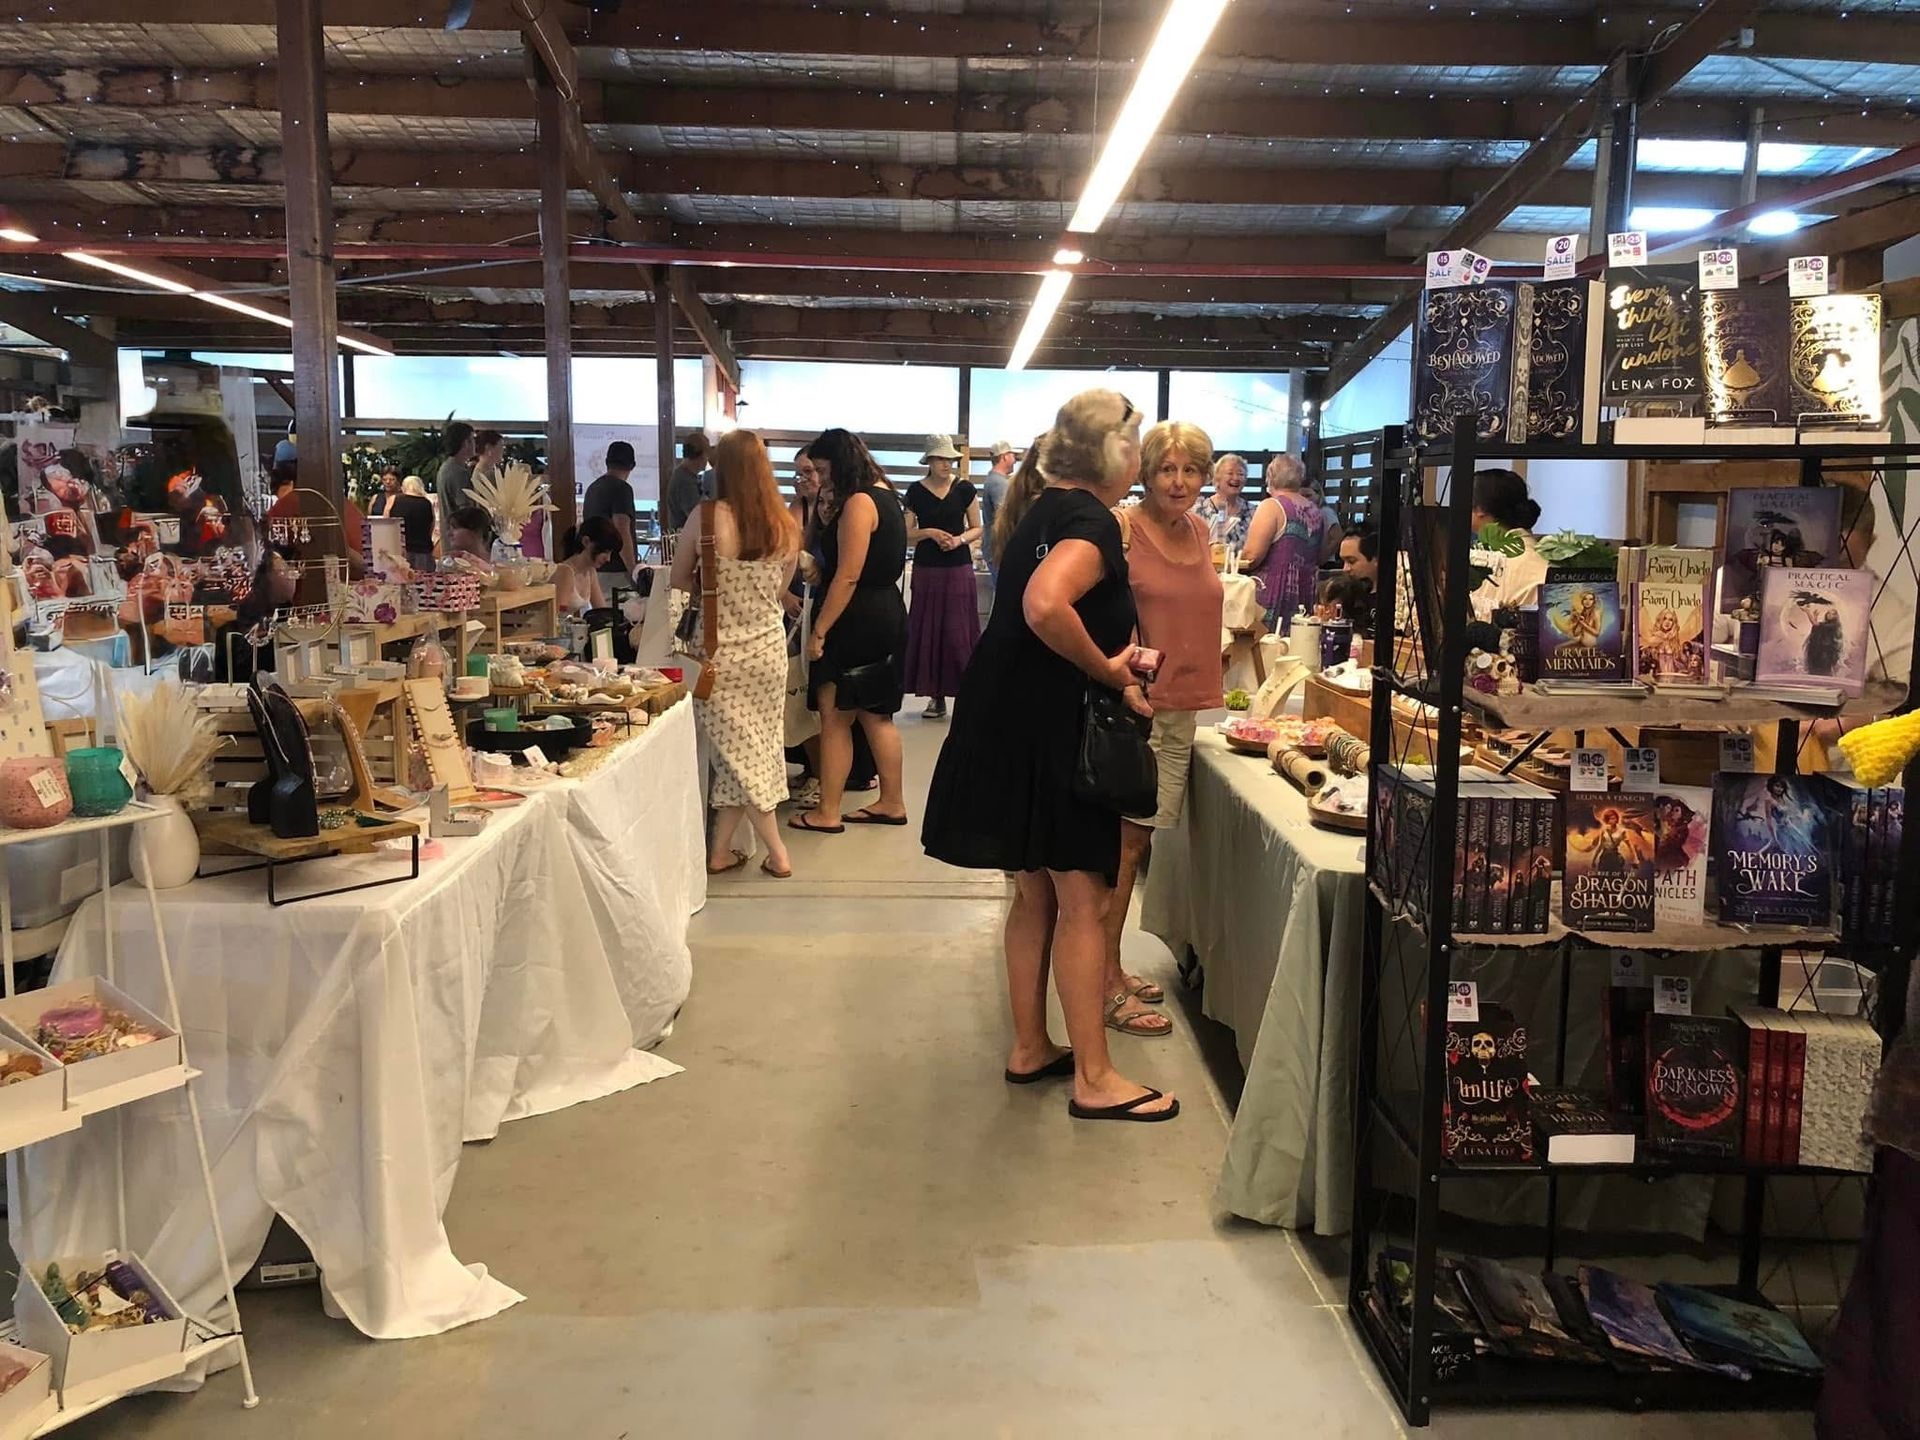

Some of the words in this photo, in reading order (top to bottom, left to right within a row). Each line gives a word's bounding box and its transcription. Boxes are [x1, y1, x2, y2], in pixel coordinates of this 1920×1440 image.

[1547, 253, 1575, 266] SALE!
[1611, 379, 1654, 391] LENA
[1662, 377, 1696, 390] FOX
[1787, 572, 1851, 582] PRACTICAL
[1794, 581, 1845, 590] MAGIC
[1553, 646, 1598, 657] ORACLE
[1545, 657, 1616, 671] MERMAIDS
[1728, 850, 1817, 873] MEMORY'S
[1574, 874, 1647, 893] DRAGON
[1735, 869, 1820, 897] WAKE
[1569, 892, 1653, 910] SHADOW
[1656, 1065, 1736, 1085] DARKNESS
[1655, 1078, 1736, 1098] UNKNOWN
